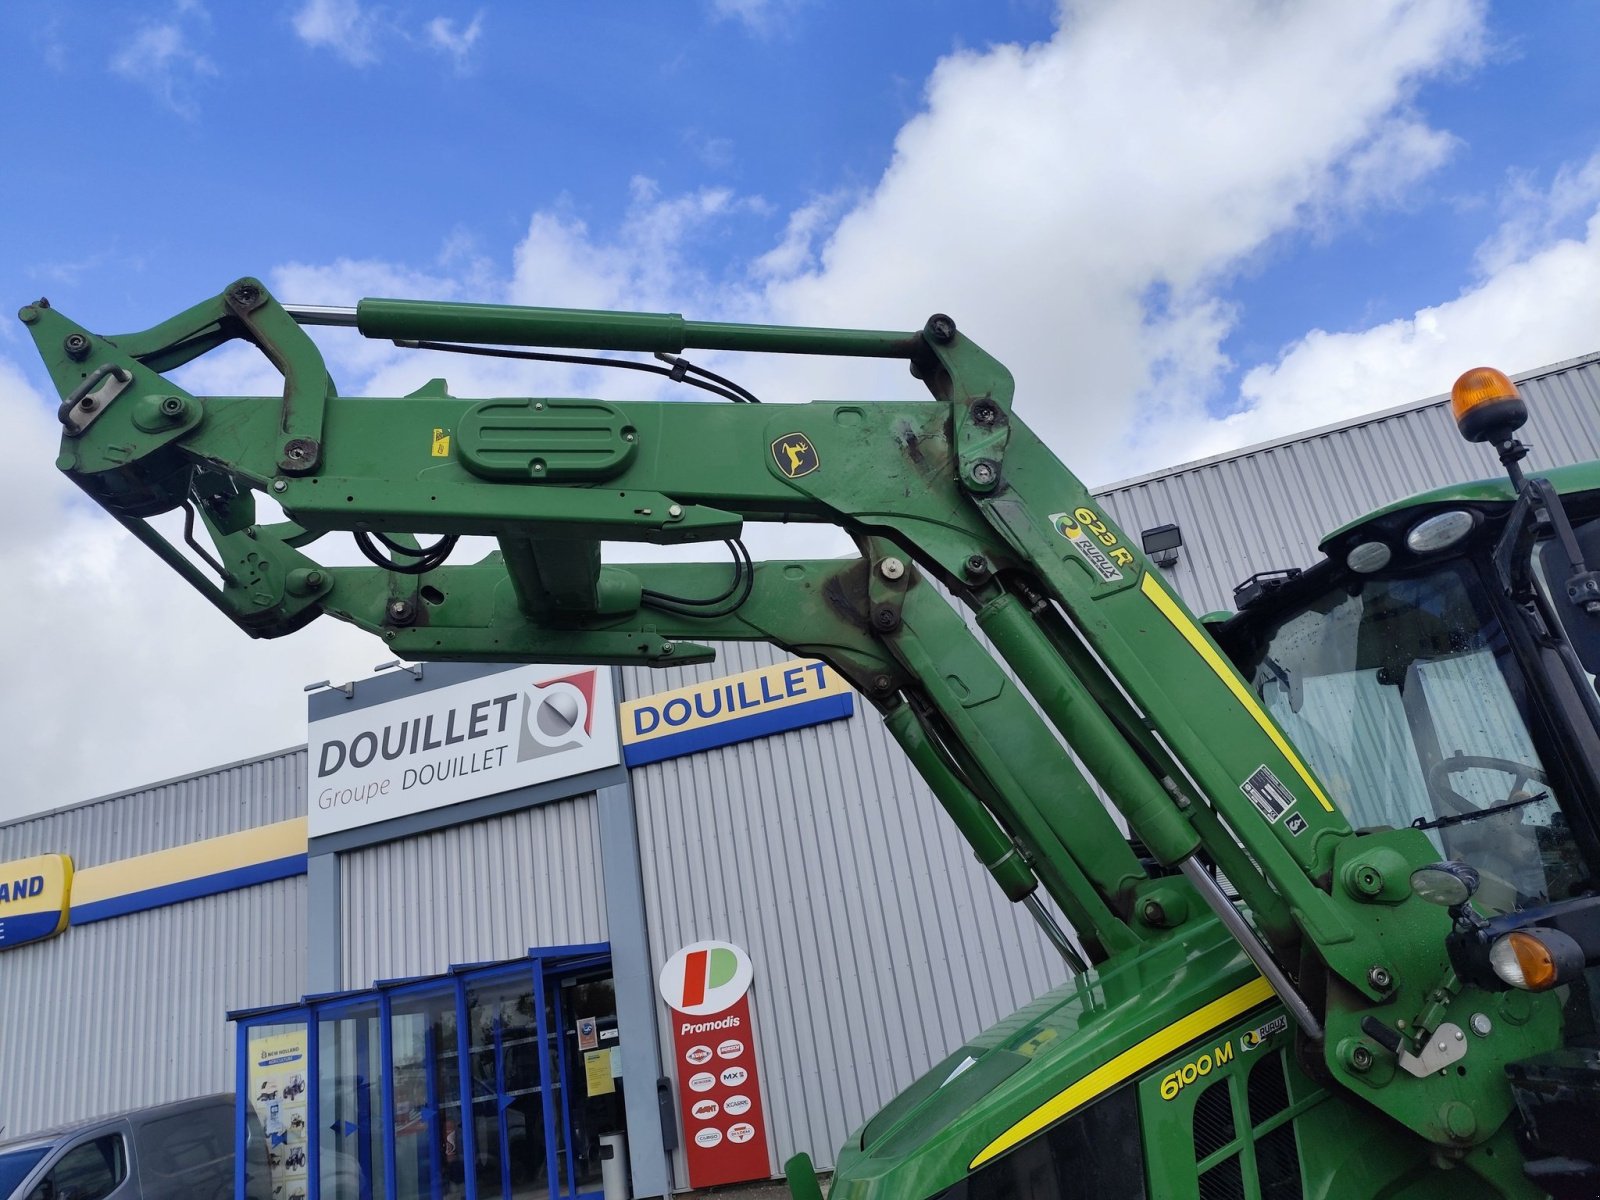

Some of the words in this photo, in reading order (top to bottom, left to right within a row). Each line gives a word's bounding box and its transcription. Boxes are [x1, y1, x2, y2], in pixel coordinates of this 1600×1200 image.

[1074, 507, 1118, 547] 623
[1108, 547, 1134, 568] R
[634, 661, 828, 736] DOUILLET
[317, 693, 517, 778] DOUILLET
[318, 778, 391, 810] Groupe
[402, 745, 508, 791] DOUILLET
[681, 1015, 741, 1035] Promodis
[1160, 1054, 1213, 1101] 6100
[1214, 1040, 1234, 1067] M
